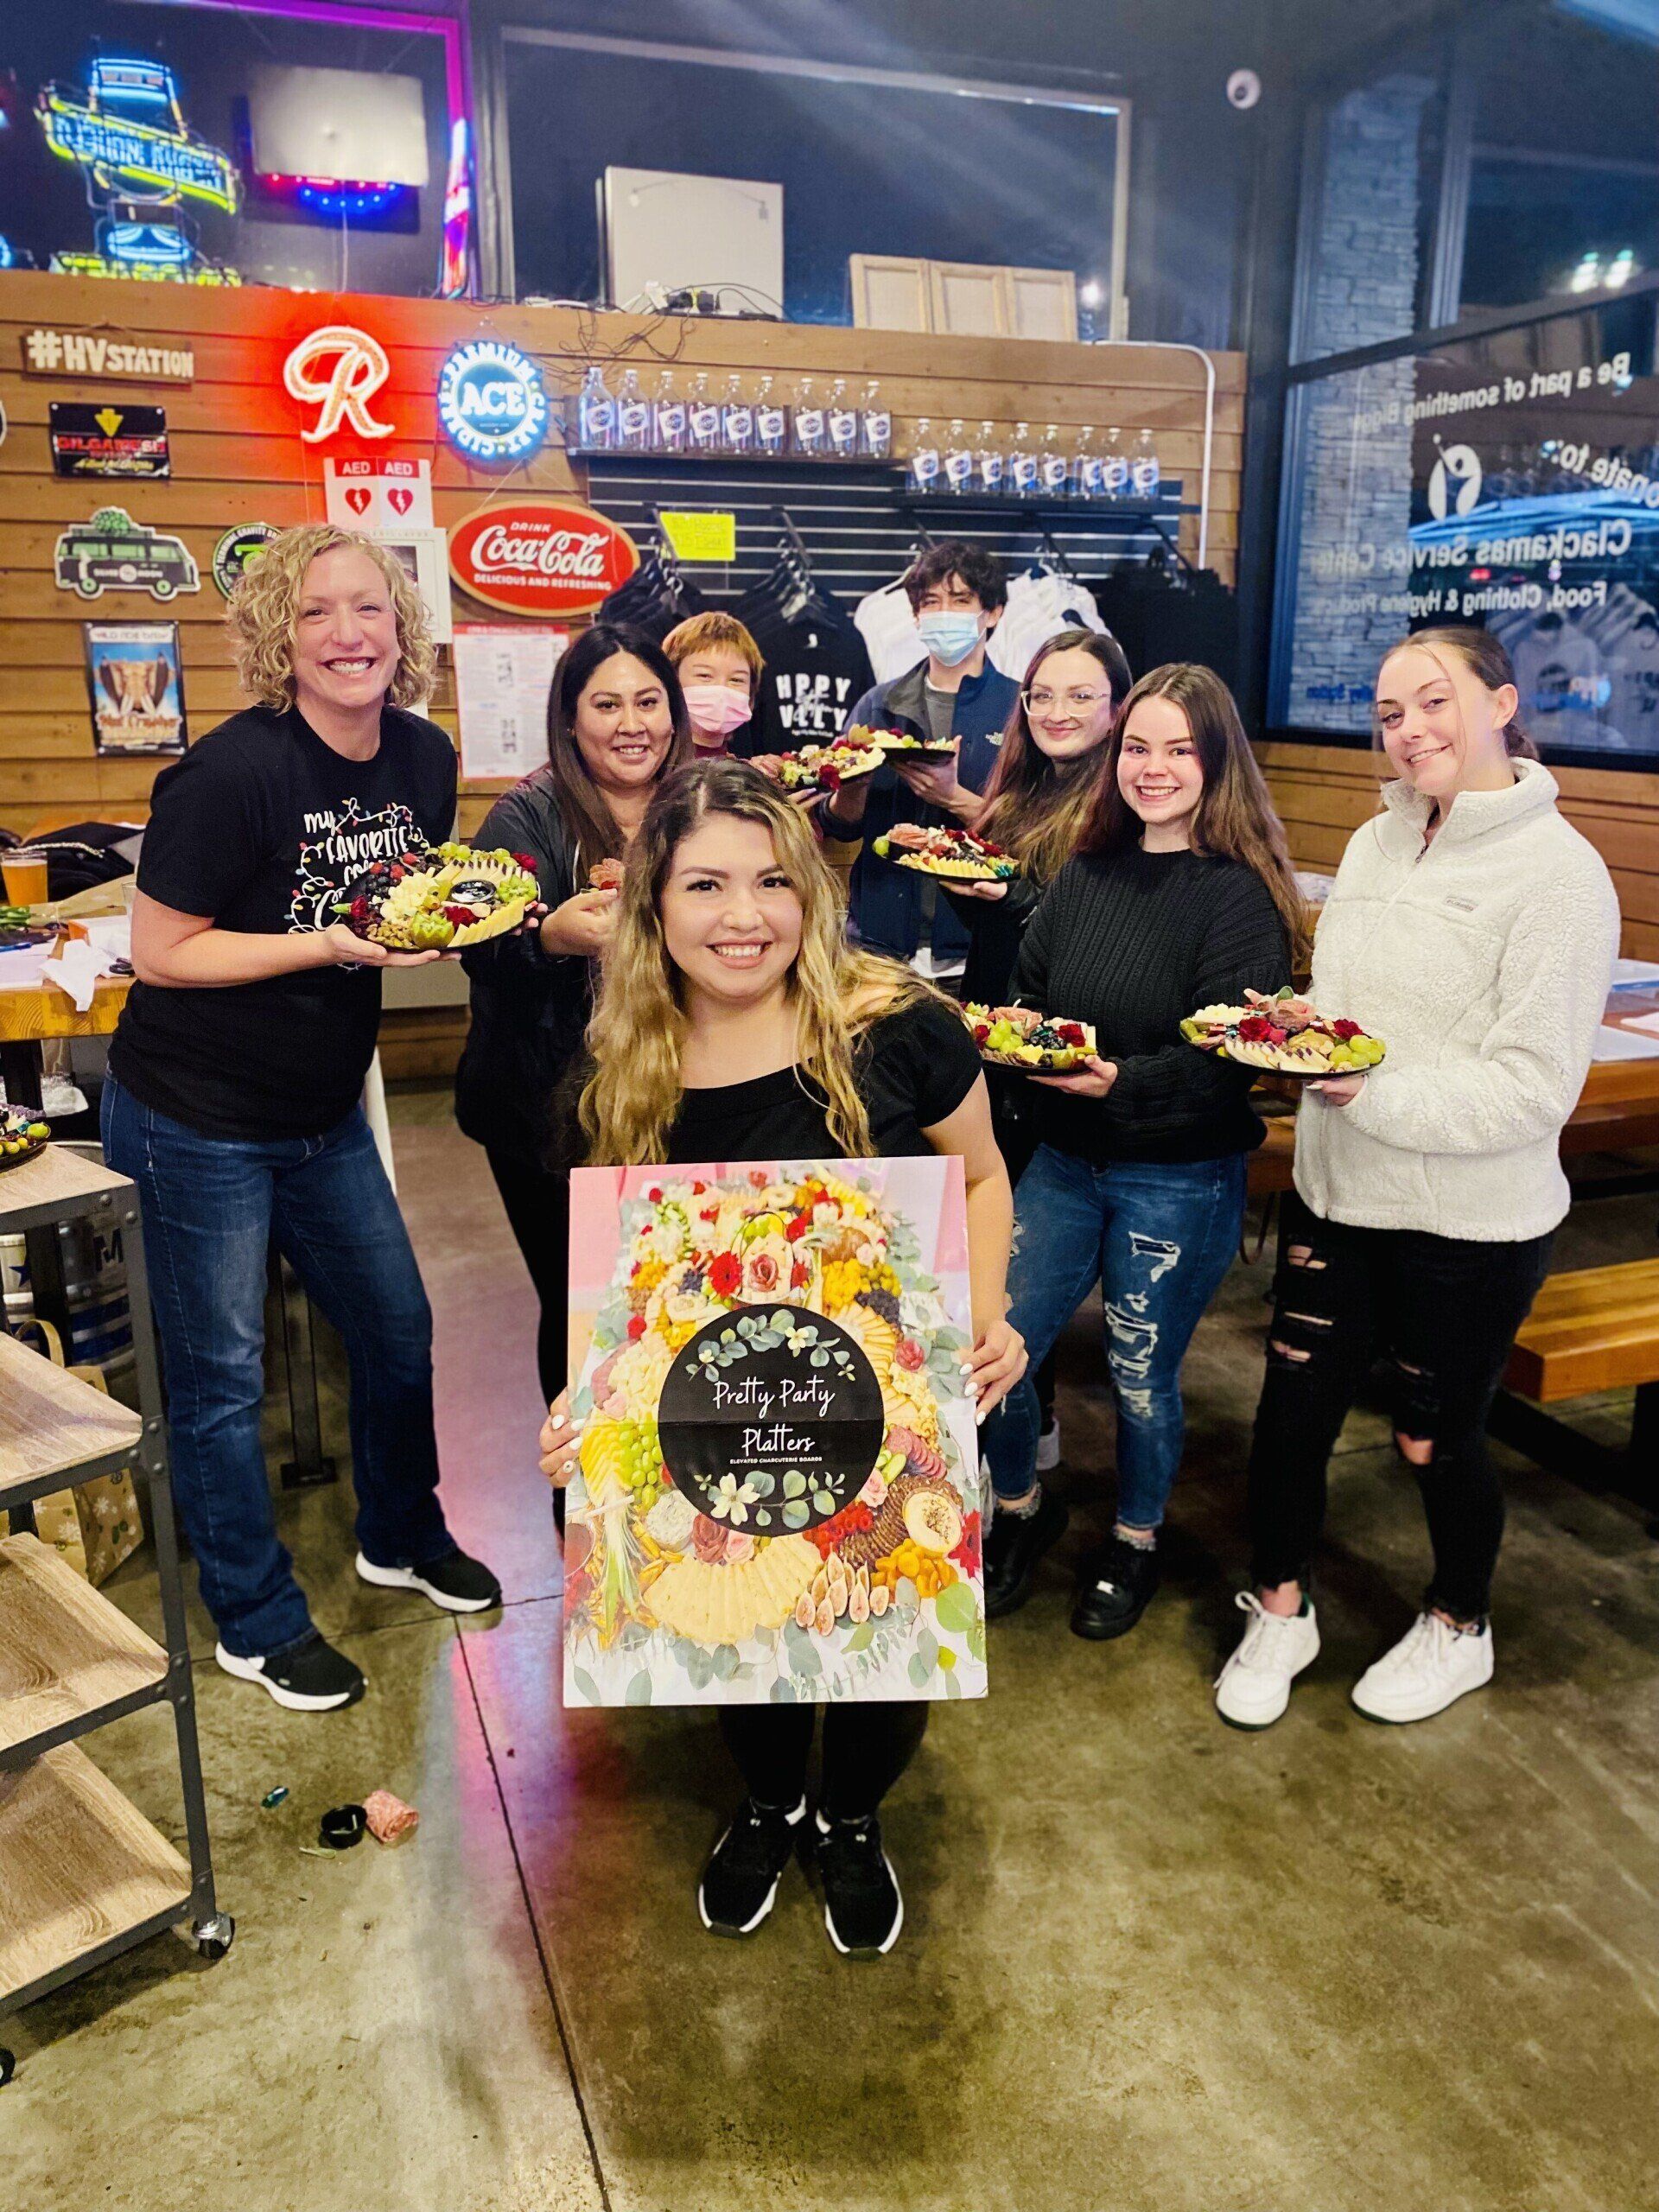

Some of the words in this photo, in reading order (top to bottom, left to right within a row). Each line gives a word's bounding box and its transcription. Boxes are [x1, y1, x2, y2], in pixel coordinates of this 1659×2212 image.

[442, 342, 536, 384] PREMIUM
[460, 382, 526, 416] ACE
[342, 461, 371, 474] AED
[385, 462, 413, 476] AED
[510, 522, 552, 533] DRINK
[470, 524, 610, 577] Coca-Cola
[474, 574, 526, 587] DELICIOUS
[528, 578, 550, 588] AND
[551, 581, 612, 591] REFRESHING
[776, 673, 851, 702] HPPY
[303, 810, 336, 836] my
[325, 826, 410, 864] FAVORITE
[712, 1376, 775, 1420] Pretty
[779, 1375, 836, 1417] Party
[741, 1424, 815, 1456] Platters
